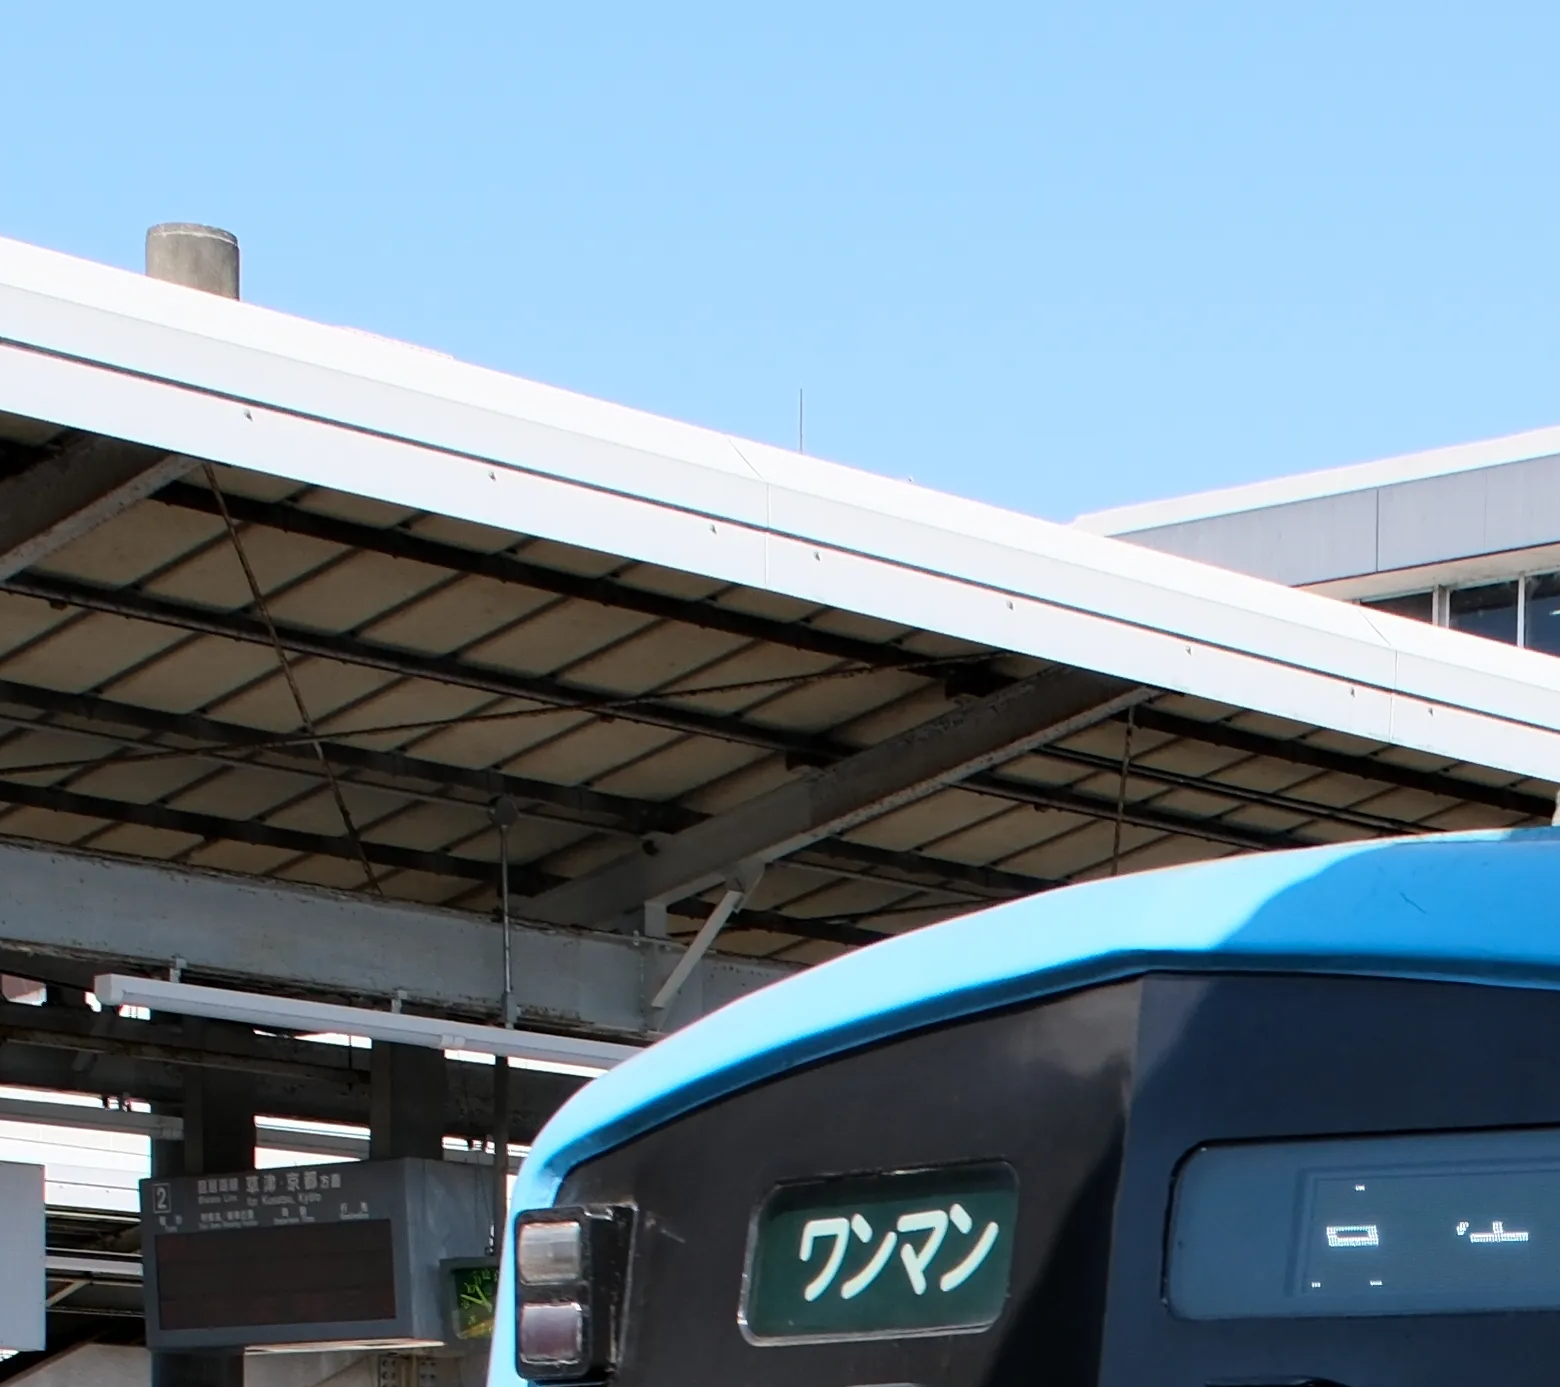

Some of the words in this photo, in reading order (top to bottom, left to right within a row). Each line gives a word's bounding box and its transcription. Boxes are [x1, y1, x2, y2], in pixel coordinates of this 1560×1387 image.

[156, 1188, 167, 1209] 2
[799, 1203, 999, 1301] ワンマン
